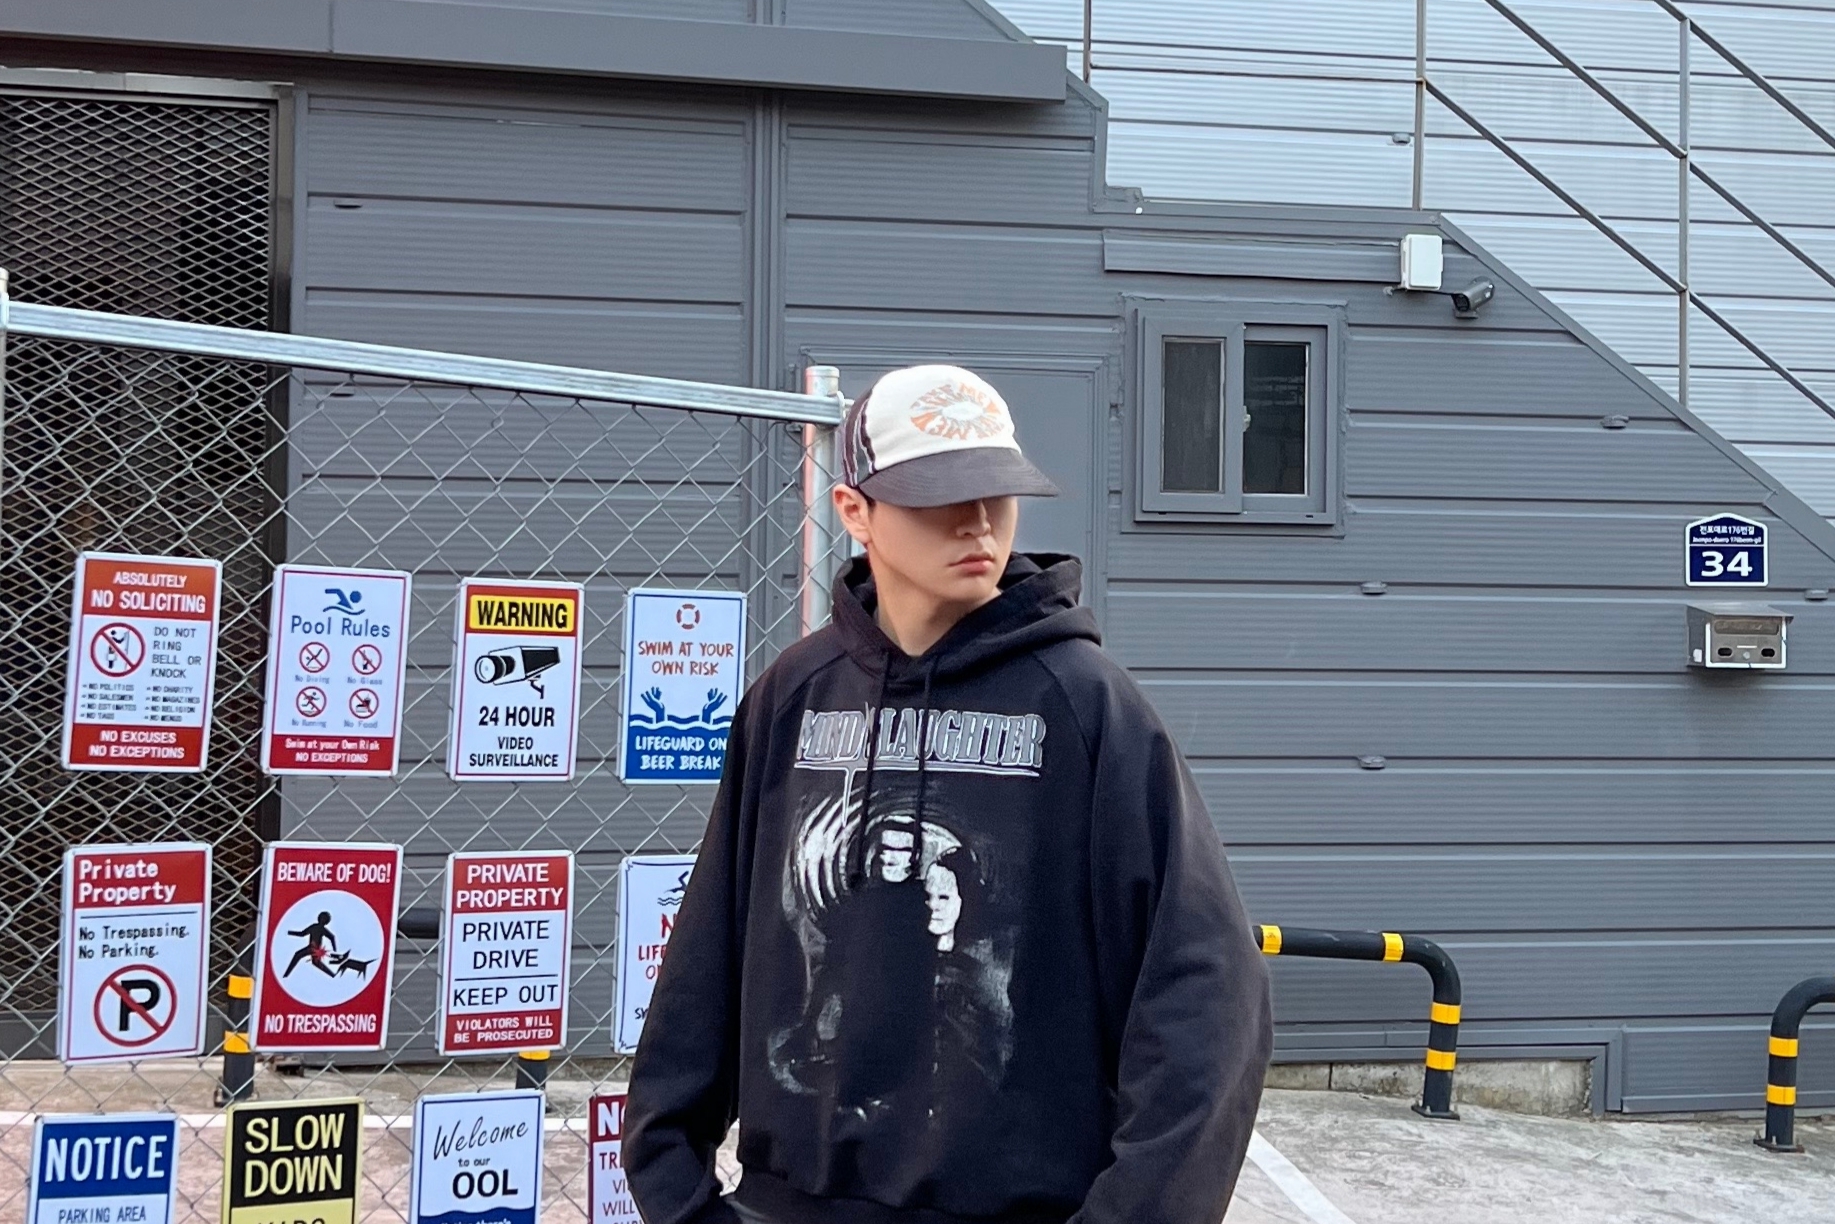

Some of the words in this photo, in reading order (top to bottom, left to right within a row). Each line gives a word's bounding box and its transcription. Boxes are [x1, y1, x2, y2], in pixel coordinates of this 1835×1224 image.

[1701, 550, 1753, 576] 34
[113, 572, 187, 588] ABSOLUTELY
[91, 590, 114, 607] NO
[119, 591, 205, 613] SOLICITING
[477, 600, 568, 628] WARNING
[154, 627, 169, 636] DO
[176, 628, 196, 638] NOT
[291, 616, 331, 634] Pool
[342, 618, 390, 637] Rules
[153, 642, 181, 651] RING
[638, 641, 673, 656] SWIM
[679, 642, 693, 656] AT
[699, 643, 734, 657] YOUR
[152, 655, 180, 664] BELL
[188, 656, 201, 665] OR
[652, 661, 684, 675] OWN
[690, 661, 719, 675] RISK
[151, 669, 186, 678] KNOCK
[479, 706, 499, 726] 24
[505, 707, 555, 727] HOUR
[100, 730, 117, 742] NO
[121, 731, 176, 743] EXCUSES
[498, 737, 534, 750] VIDEO
[635, 736, 705, 751] LIFEGUARD
[709, 737, 727, 750] ON
[89, 746, 107, 756] NO
[110, 747, 184, 758] EXCEPTIONS
[296, 752, 309, 761] NO
[311, 753, 368, 763] EXCEPTIONS
[469, 754, 558, 767] SURVEILLANCE
[640, 755, 674, 770] BEER
[679, 755, 721, 770] BREAK
[80, 859, 158, 880] Private
[277, 862, 333, 882] BEWARE
[336, 864, 355, 882] OF
[358, 863, 391, 883] DOG!
[467, 863, 549, 884] PRIVATE
[79, 883, 176, 904] Property
[456, 887, 564, 908] PROPERTY
[79, 927, 95, 941] No
[463, 920, 550, 942] PRIVATE
[662, 914, 677, 938] N
[78, 946, 94, 959] No
[473, 949, 539, 970] DRIVE
[453, 987, 508, 1007] KEEP
[519, 985, 558, 1003] OUT
[264, 1014, 284, 1033] NO
[287, 1015, 376, 1033] TRESPASSING
[456, 1018, 519, 1031] VIOLATORS
[525, 1016, 553, 1027] WILL
[454, 1033, 470, 1043] BE
[477, 1029, 554, 1042] PROSECUTED
[598, 1102, 626, 1137] N
[245, 1113, 346, 1153] SLOW
[434, 1116, 529, 1160] Welcome
[45, 1135, 167, 1182] NOTICE
[458, 1159, 470, 1167] to
[474, 1158, 491, 1166] our
[244, 1154, 343, 1198] DOWN
[453, 1169, 518, 1199] OOL
[58, 1207, 110, 1224] PARKING
[117, 1206, 146, 1221] AREA
[602, 1201, 636, 1217] WILL
